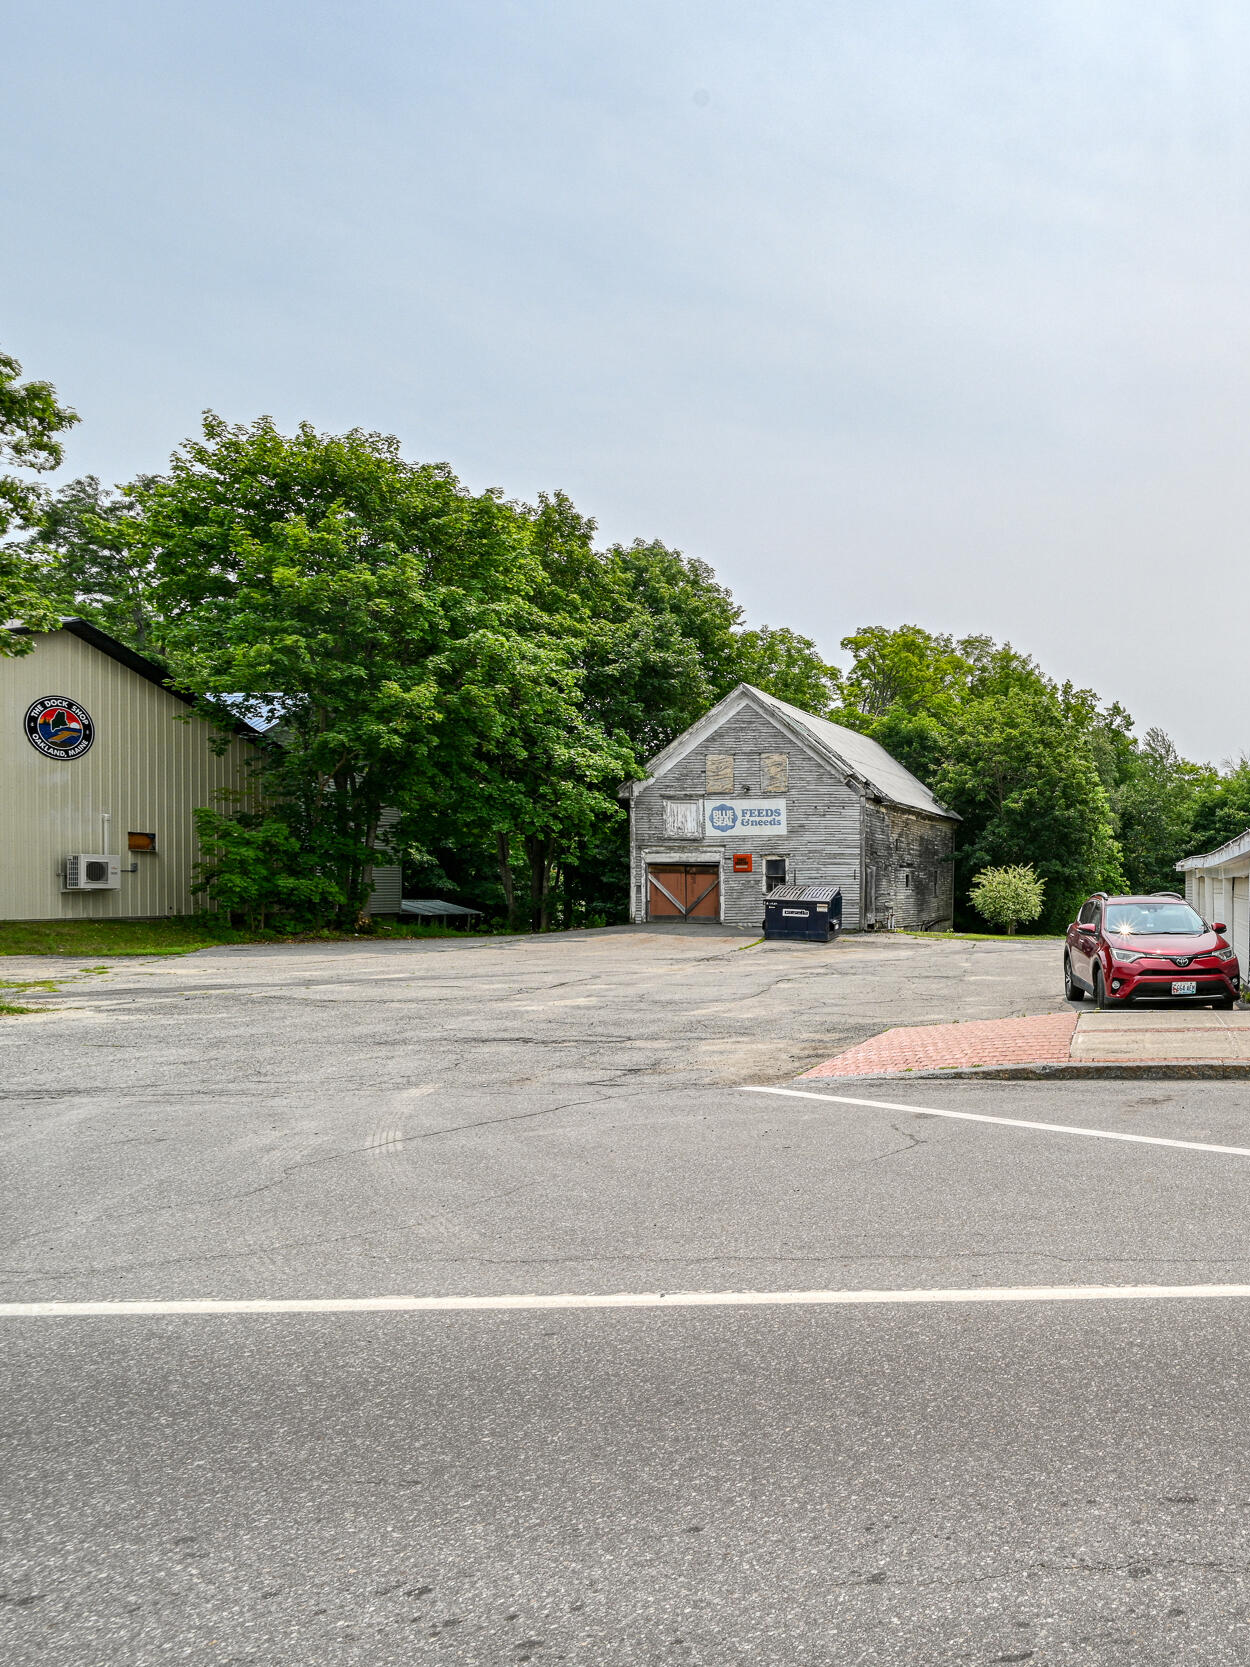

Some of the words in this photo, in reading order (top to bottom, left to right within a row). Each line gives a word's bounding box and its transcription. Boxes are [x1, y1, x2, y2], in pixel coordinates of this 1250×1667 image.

[30, 704, 44, 718] THE
[44, 699, 69, 708] DOCK
[71, 705, 89, 725] SHOP
[32, 733, 67, 757] OAKLAND,
[68, 739, 89, 757] MAINE
[712, 810, 735, 818] BLUE
[741, 808, 782, 818] FEEDS
[713, 817, 735, 826] SEAL
